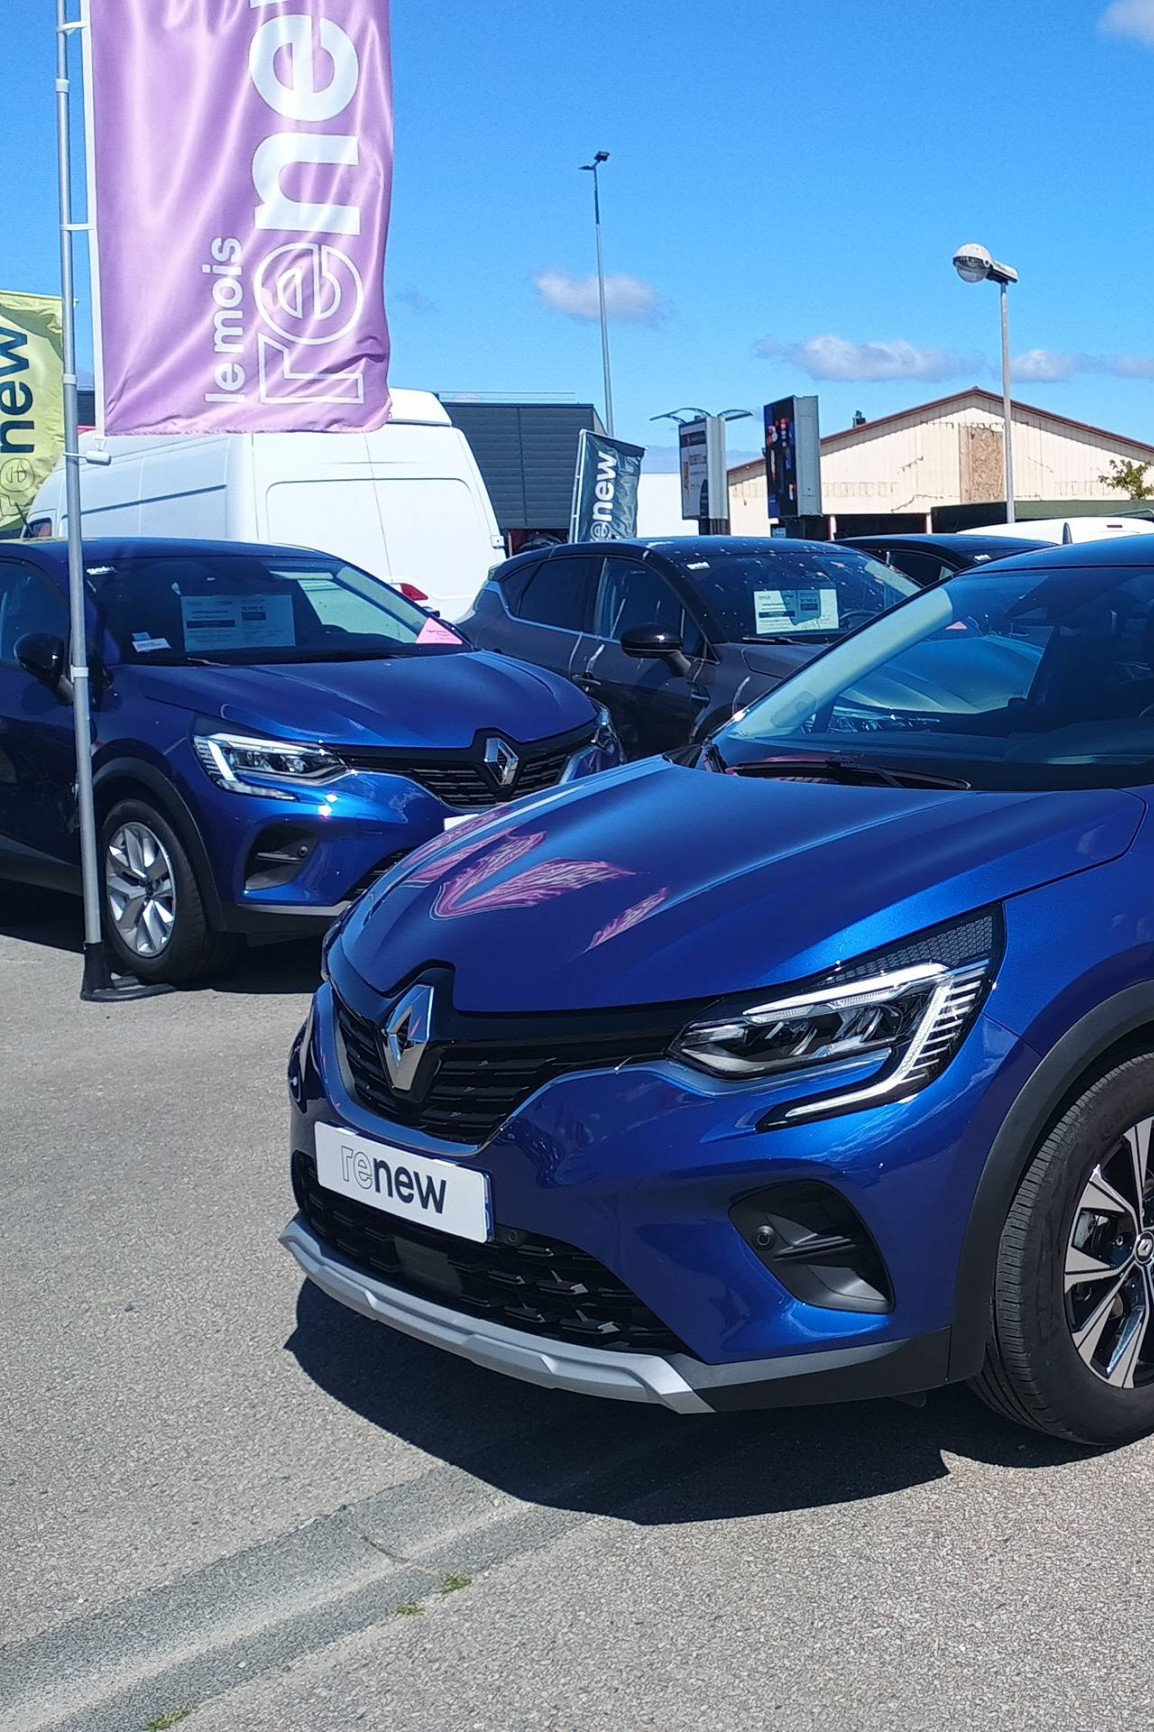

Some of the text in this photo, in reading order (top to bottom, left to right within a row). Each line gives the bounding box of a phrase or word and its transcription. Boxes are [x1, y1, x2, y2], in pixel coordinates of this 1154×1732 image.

[248, 0, 364, 404] rene
[202, 237, 246, 402] le mois
[589, 450, 617, 542] enew
[341, 1145, 446, 1214] renew
